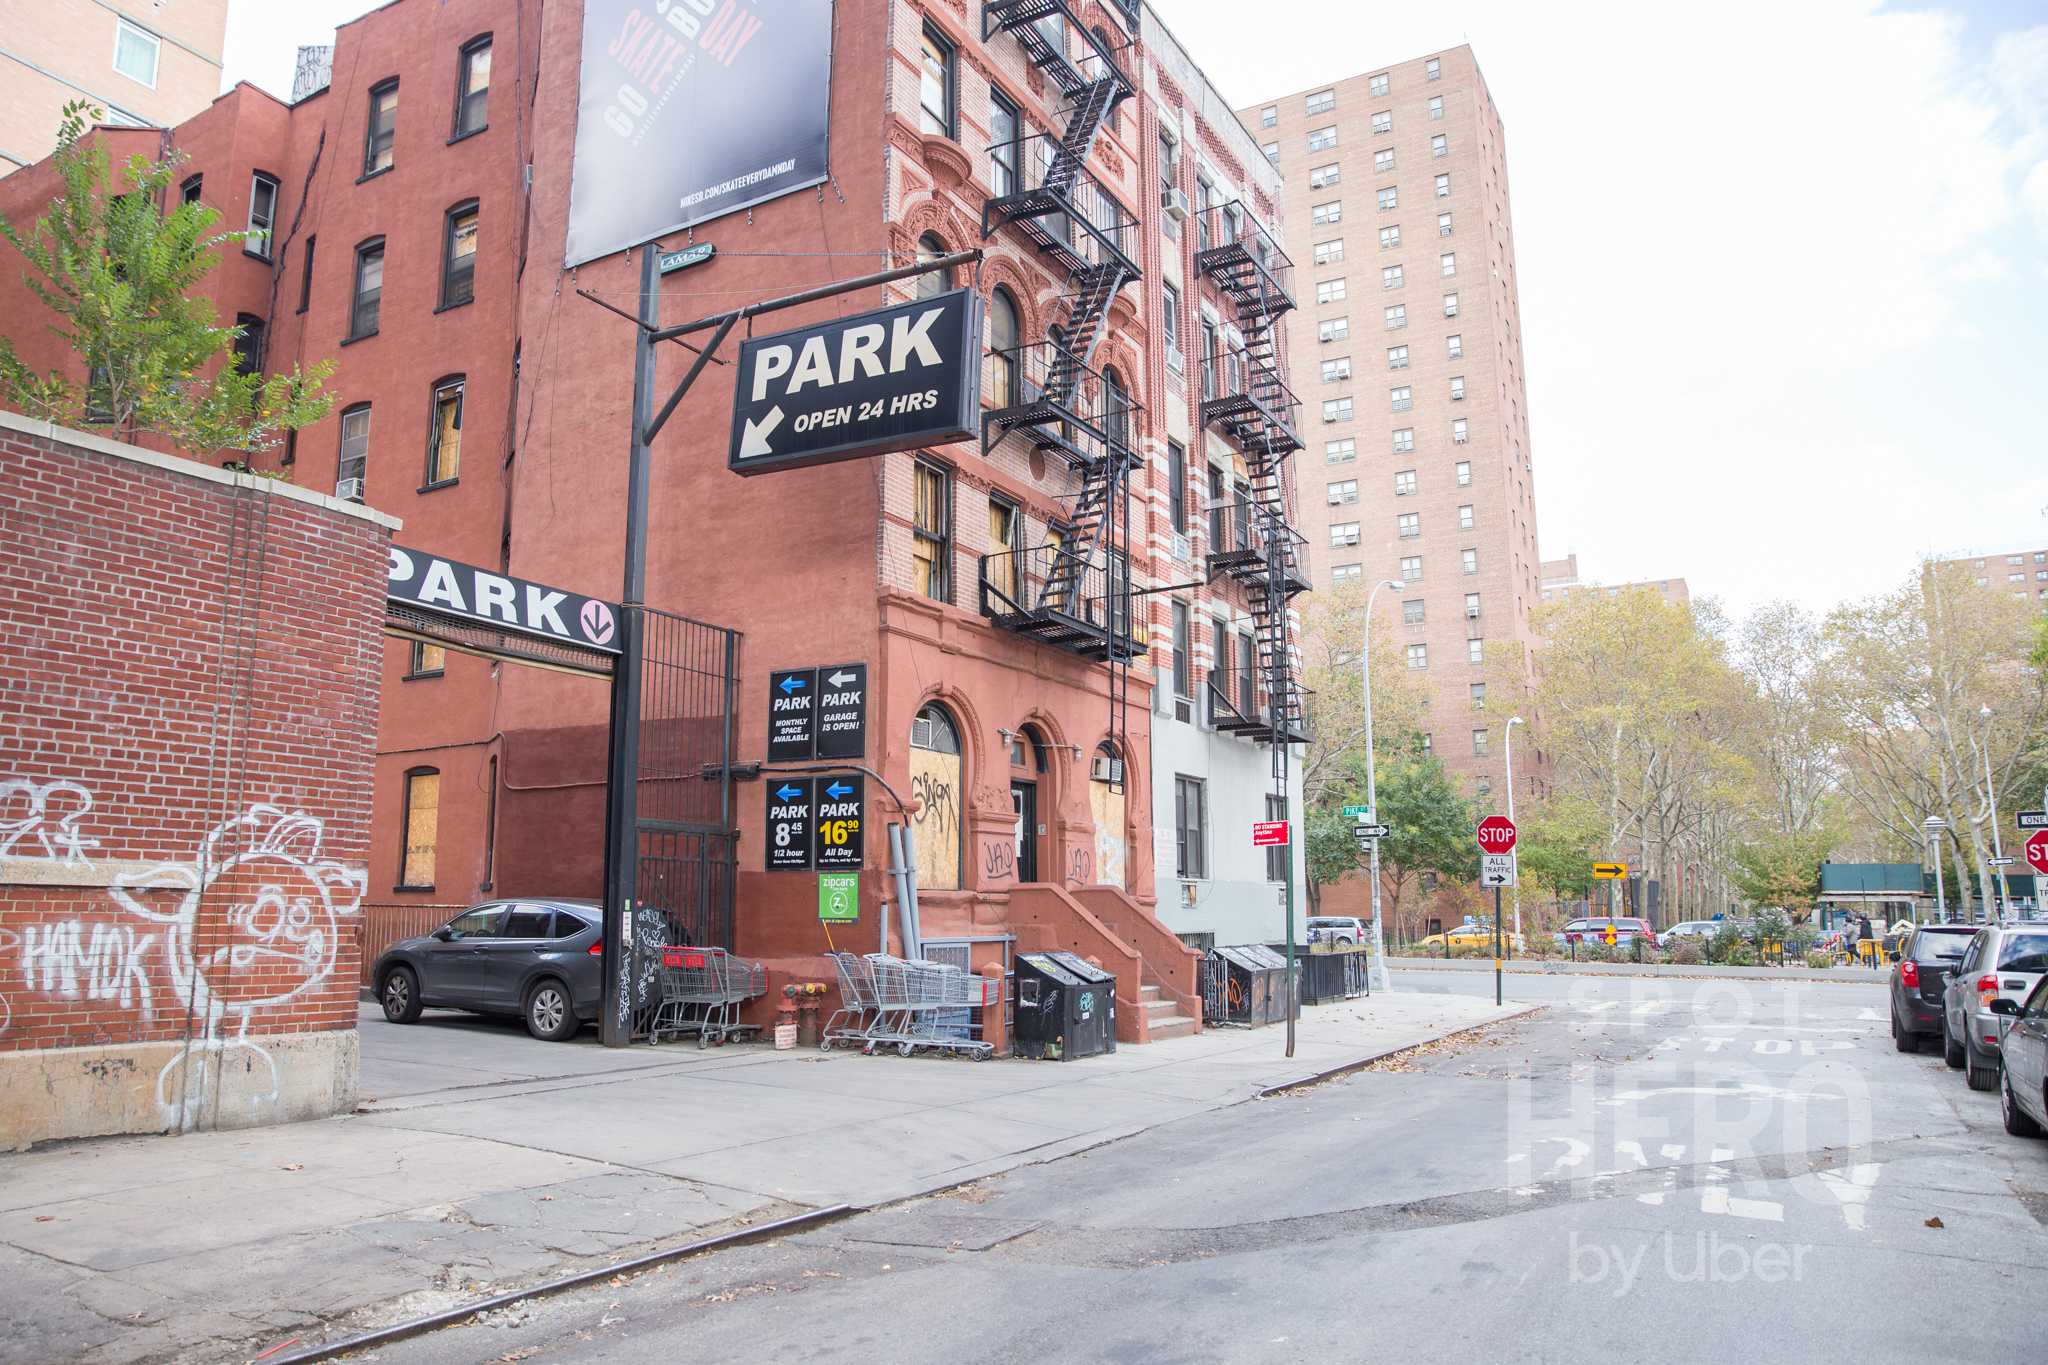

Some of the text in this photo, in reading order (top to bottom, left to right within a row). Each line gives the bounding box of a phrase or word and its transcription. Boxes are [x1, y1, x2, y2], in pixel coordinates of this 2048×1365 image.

[603, 84, 648, 138] GO
[751, 307, 945, 402] PARK
[793, 389, 938, 433] OPEN 24 HRS
[388, 548, 570, 637] PARK
[773, 696, 811, 711] PARK
[821, 691, 862, 707] PARK
[775, 718, 808, 727] MONTHLY
[824, 712, 858, 721] GARAGE
[780, 726, 802, 734] SPACE
[822, 721, 860, 731] IS OPEN!
[773, 734, 809, 743] AVAILABLE
[770, 805, 808, 819] PARK
[819, 802, 860, 817] PARK
[2026, 816, 2045, 824] ONE
[775, 822, 803, 846] 8 45
[820, 820, 859, 845] 16 90
[1480, 827, 1513, 843] STOP
[773, 849, 804, 857] 1/2 hour
[825, 848, 853, 858] All Day
[1489, 858, 1506, 866] ALL
[1484, 866, 1511, 874] TRAFFIC
[823, 876, 855, 888] zipcars
